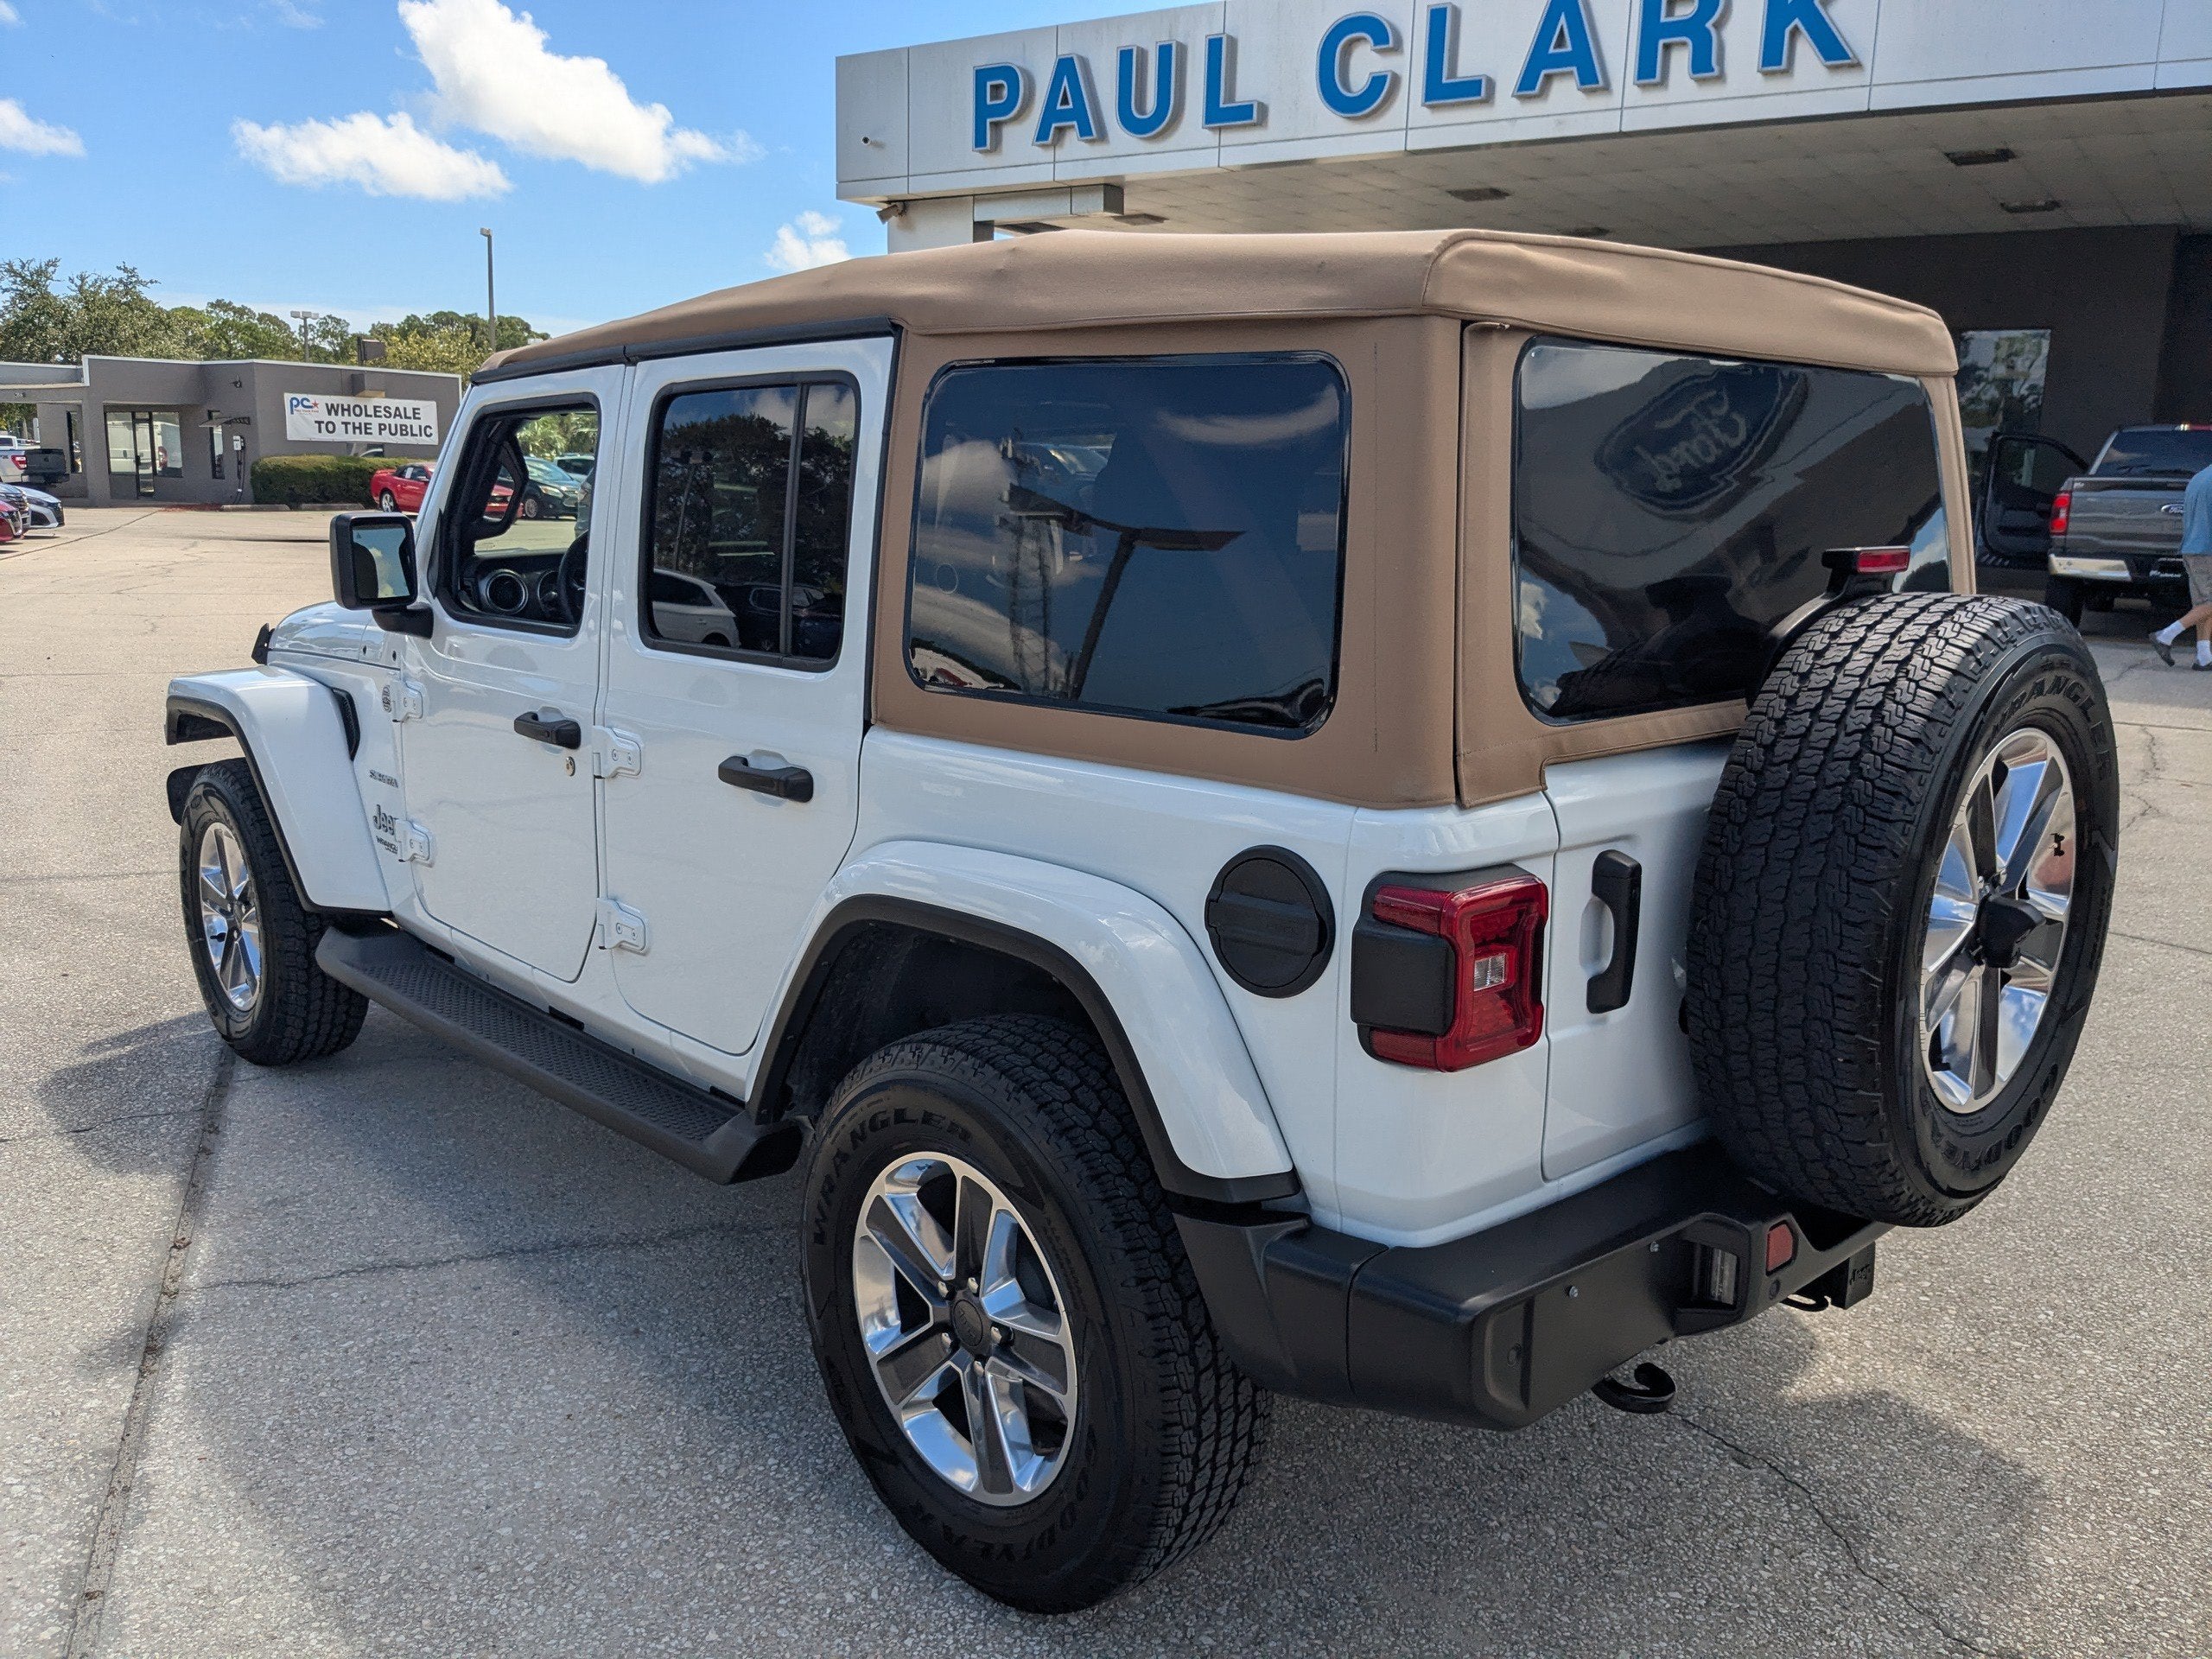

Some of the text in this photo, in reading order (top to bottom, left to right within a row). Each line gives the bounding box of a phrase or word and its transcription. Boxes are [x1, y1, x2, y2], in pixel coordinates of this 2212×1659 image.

[972, 0, 1854, 151] PAUL CLARK
[325, 403, 422, 420] WHOLESALE
[315, 420, 434, 438] TO THE PUBLIC
[373, 804, 395, 836] Jee
[812, 1107, 973, 1246] WRANGLER
